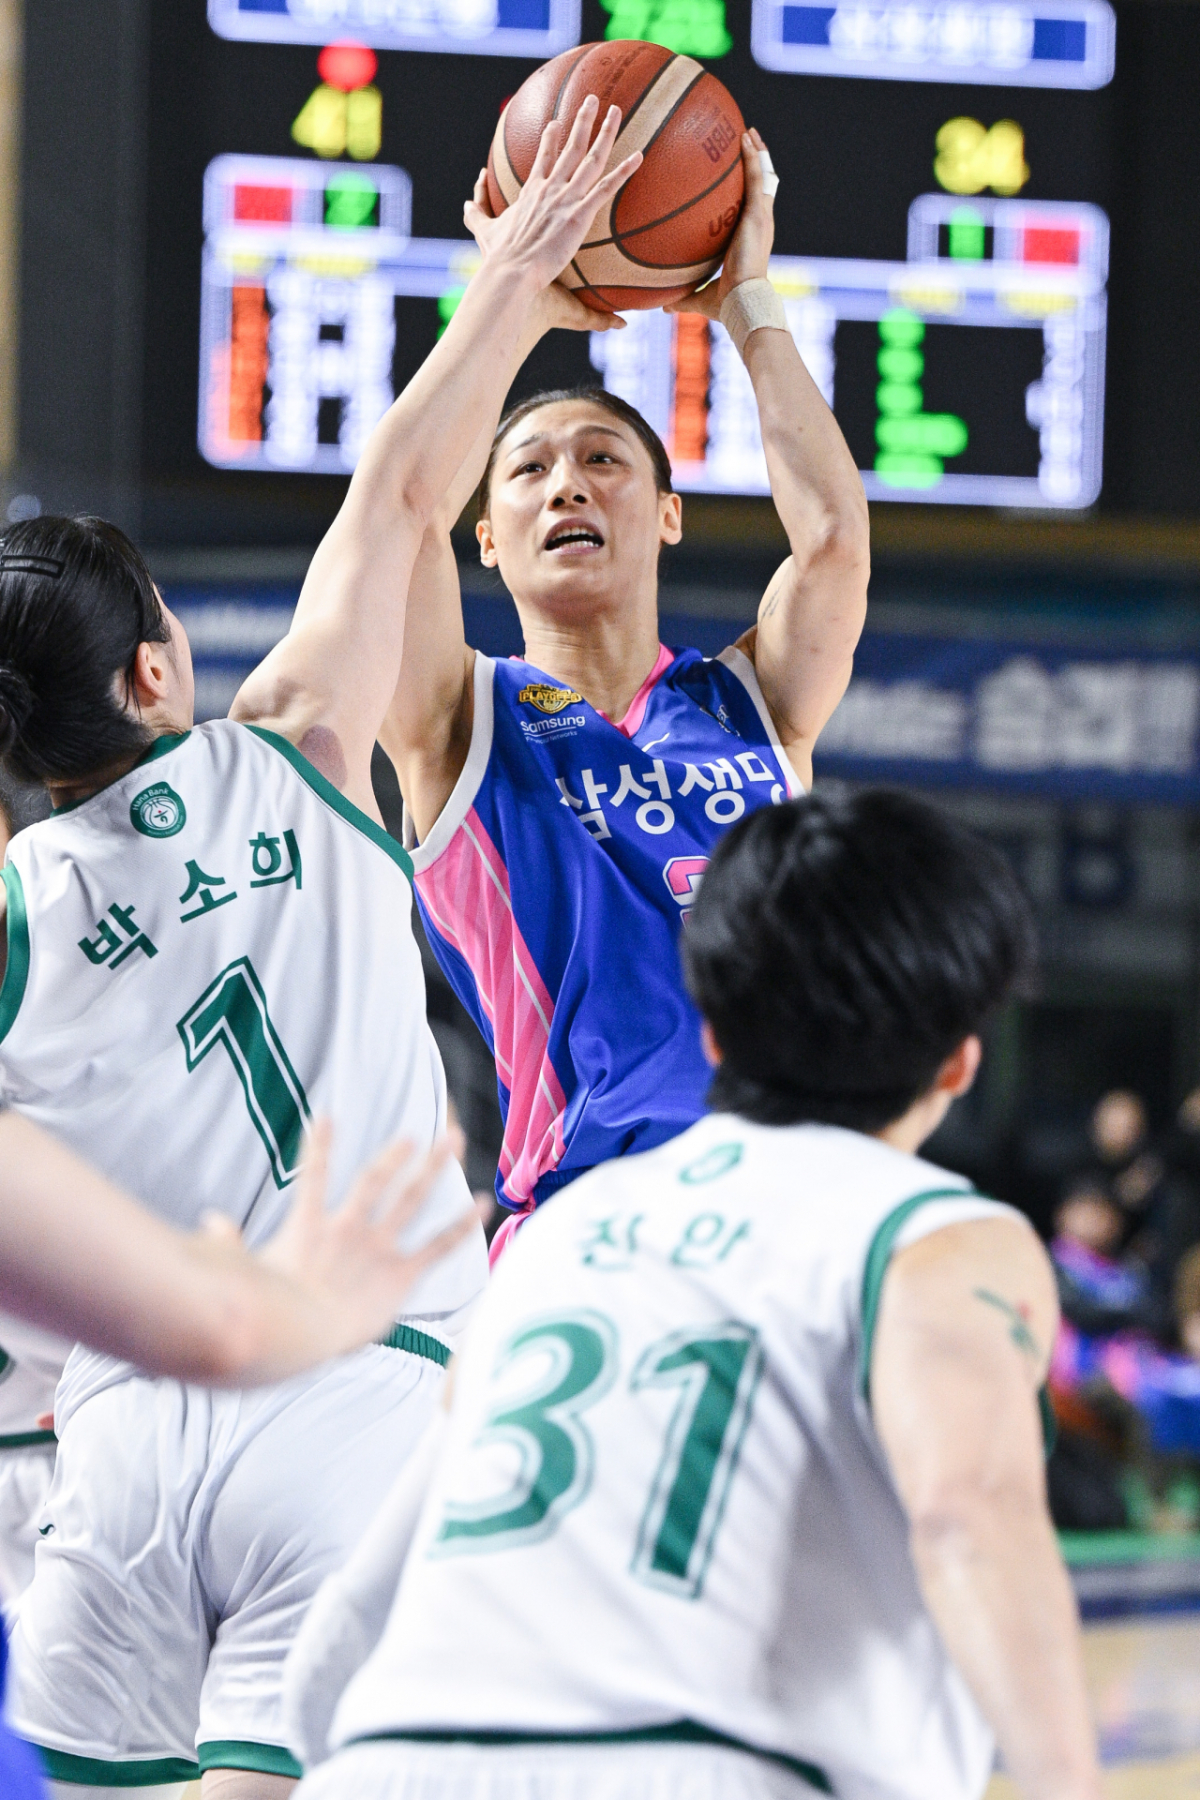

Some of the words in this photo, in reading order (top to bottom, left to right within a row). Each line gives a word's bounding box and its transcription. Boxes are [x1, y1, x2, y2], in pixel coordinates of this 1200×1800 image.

[701, 115, 737, 164] FIBA
[520, 714, 586, 734] Samsung
[132, 793, 149, 811] Hana
[148, 788, 169, 797] Bank
[426, 1307, 765, 1600] 31
